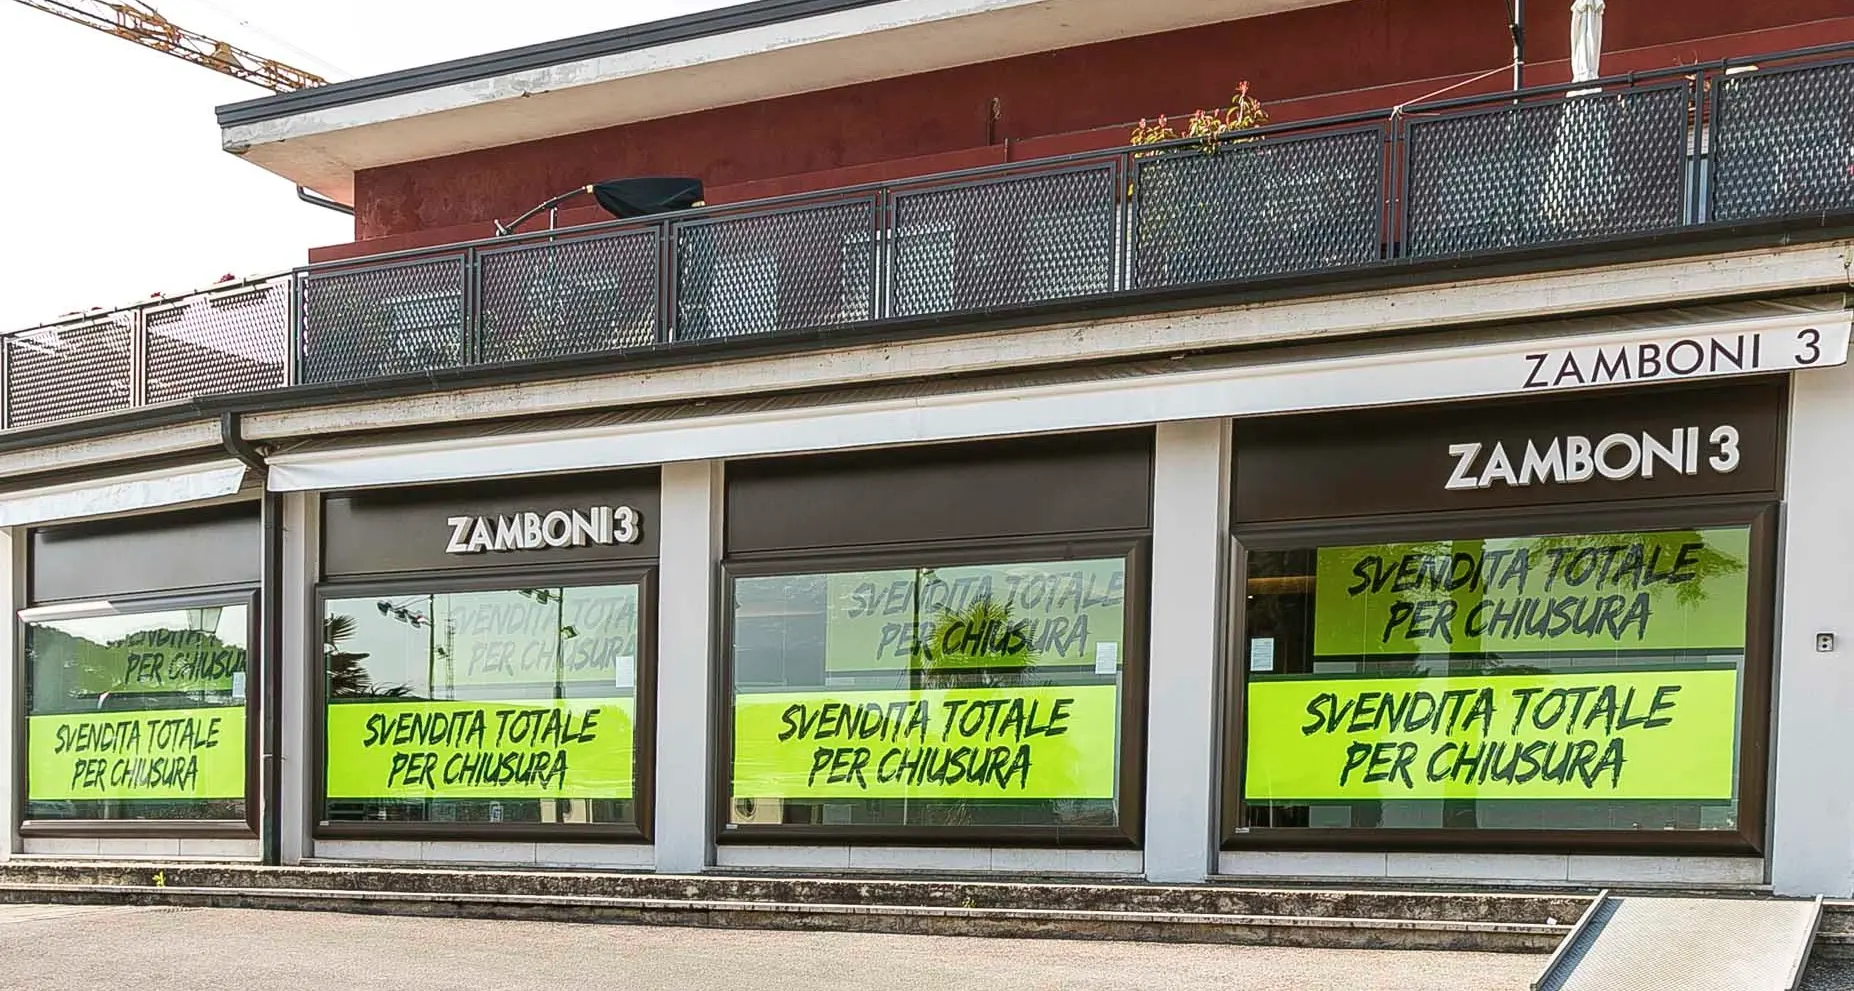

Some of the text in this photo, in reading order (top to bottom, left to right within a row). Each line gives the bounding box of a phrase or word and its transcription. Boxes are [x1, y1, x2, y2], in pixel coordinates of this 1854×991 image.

[1522, 328, 1822, 389] ZAMBONI 3
[1444, 425, 1740, 490] ZAMBONI 3
[445, 505, 641, 553] ZAMBONI 3
[1348, 541, 1704, 598] SVENDITA TOTALE
[849, 570, 1123, 619] SVENDITA TOTALE
[1382, 592, 1653, 644] PER CHIUSURA
[467, 641, 515, 677] PER
[876, 620, 934, 661] PER
[942, 613, 1092, 658] CHIUSURA
[125, 651, 165, 687] PER
[54, 717, 222, 754] SVENDITA TOTALE
[363, 708, 601, 749] SVENDITA TOTALE
[777, 698, 1075, 744] SVENDITA TOTALE
[1301, 685, 1682, 738] SVENDITA TOTALE
[71, 755, 198, 792] PER CHIUSURA
[387, 749, 569, 791] PER CHIUSURA
[808, 744, 1032, 789] PER CHIUSURA
[1340, 737, 1628, 789] PER CHIUSURA
